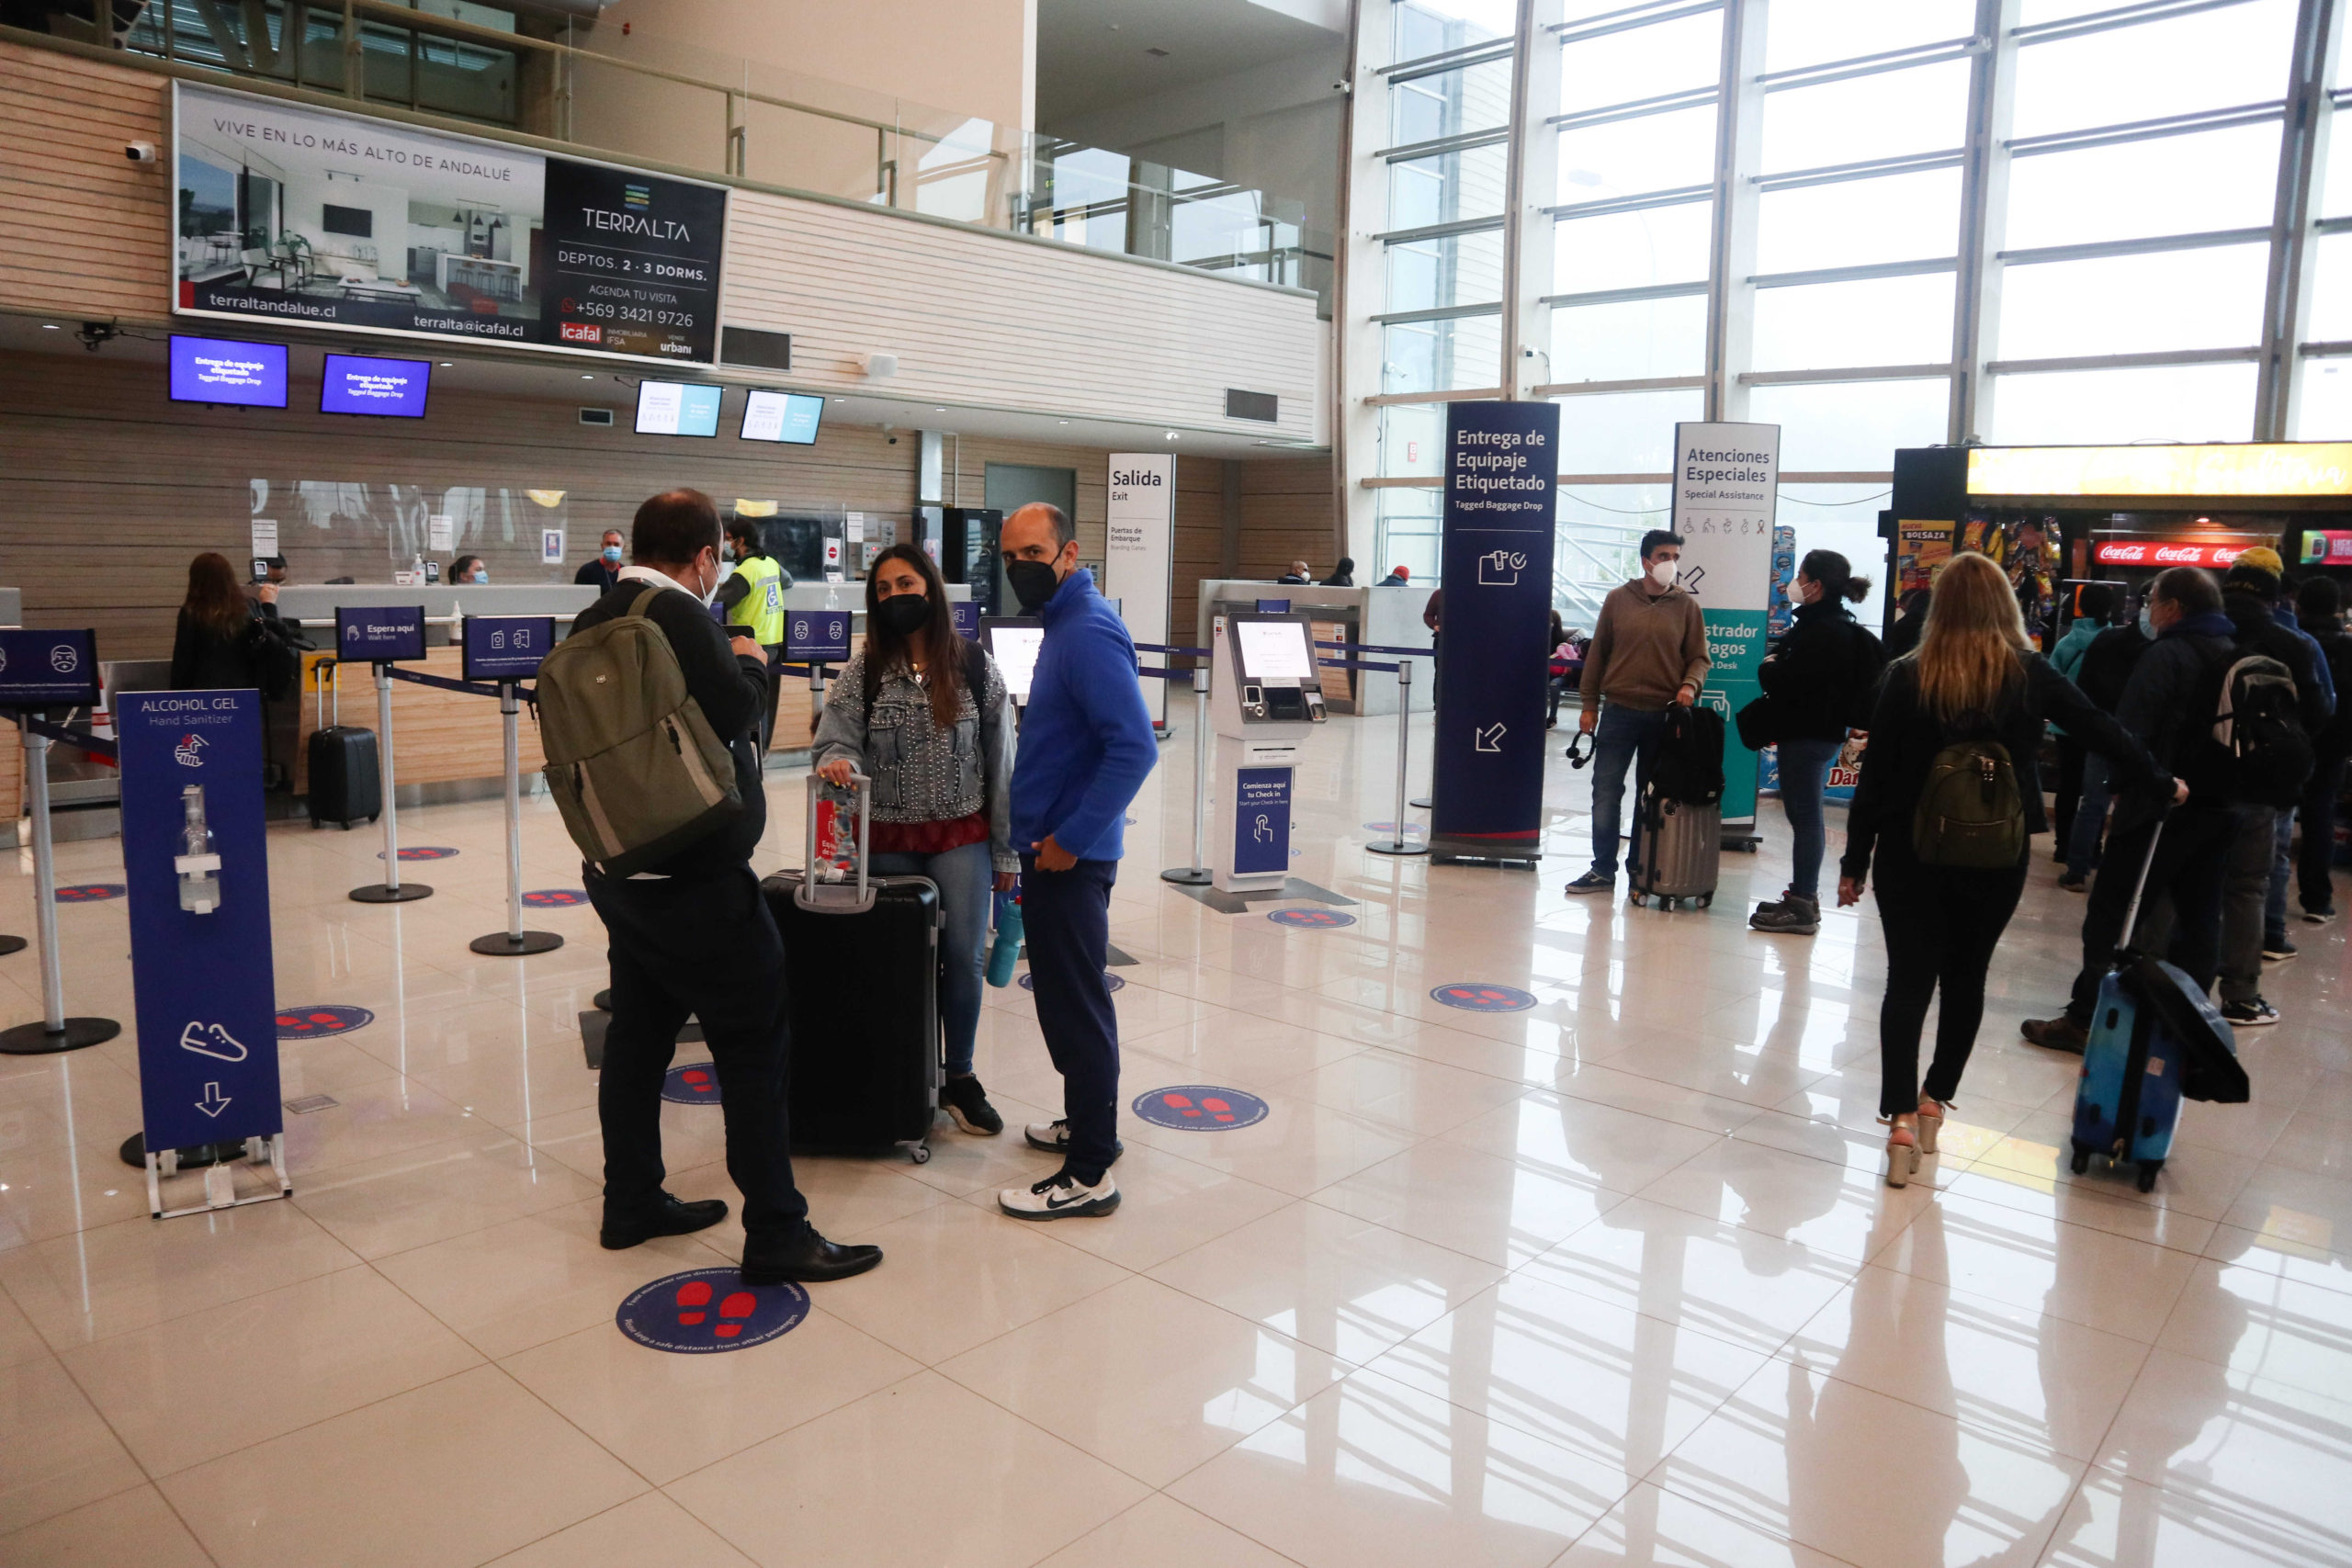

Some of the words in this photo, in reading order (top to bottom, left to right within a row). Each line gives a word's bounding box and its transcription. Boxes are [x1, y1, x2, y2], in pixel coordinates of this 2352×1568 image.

[214, 118, 255, 139] VIVE
[263, 127, 287, 143] EN
[293, 131, 317, 149] LO
[322, 138, 358, 156] MÁS
[364, 146, 407, 164] ALTO
[413, 153, 434, 169] DE
[439, 159, 511, 182] ANDALUÉ
[582, 208, 691, 243] TERRALTA
[559, 250, 618, 270] DEPTOS.
[623, 259, 631, 271] 2
[643, 263, 651, 274] 3
[656, 265, 707, 282] DORMS.
[589, 285, 630, 299] AGENDA
[633, 289, 647, 301] TU
[649, 292, 677, 305] VISITA
[209, 292, 336, 319] terraltandalue.cl
[576, 302, 615, 318] +569
[619, 306, 653, 322] 3421
[657, 310, 694, 328] 9726
[413, 314, 525, 337] terralta@icafal.cl
[561, 323, 601, 343] icafal
[606, 336, 626, 346] IFSA
[224, 359, 234, 367] de
[1456, 429, 1521, 450] Entrega
[1525, 429, 1546, 446] de
[1456, 451, 1528, 472] Equipaje
[1687, 447, 1770, 465] Atenciones
[1113, 469, 1161, 487] Salida
[1455, 474, 1546, 494] Etiquetado
[1686, 467, 1767, 485] Especiales
[1112, 491, 1129, 502] Exit
[1685, 490, 1717, 501] Special
[1719, 491, 1765, 502] Assistance
[1455, 501, 1485, 511] Tagged
[1486, 501, 1522, 513] Baggage
[1523, 502, 1544, 513] Drop
[1111, 526, 1133, 535] Puertas
[1905, 531, 1946, 540] BOLSAZA
[1110, 535, 1141, 544] Embarque
[368, 625, 395, 635] Espera
[397, 624, 414, 635] aquí
[1716, 660, 1738, 670] Desk
[141, 698, 209, 713] ALCOHOL
[212, 697, 239, 710] GEL
[149, 715, 180, 727] Hand
[184, 714, 233, 726] Sanitizer
[1242, 782, 1272, 790] Comienza
[1255, 790, 1274, 798] Check
[717, 1342, 741, 1350] from
[741, 1335, 764, 1346] other
